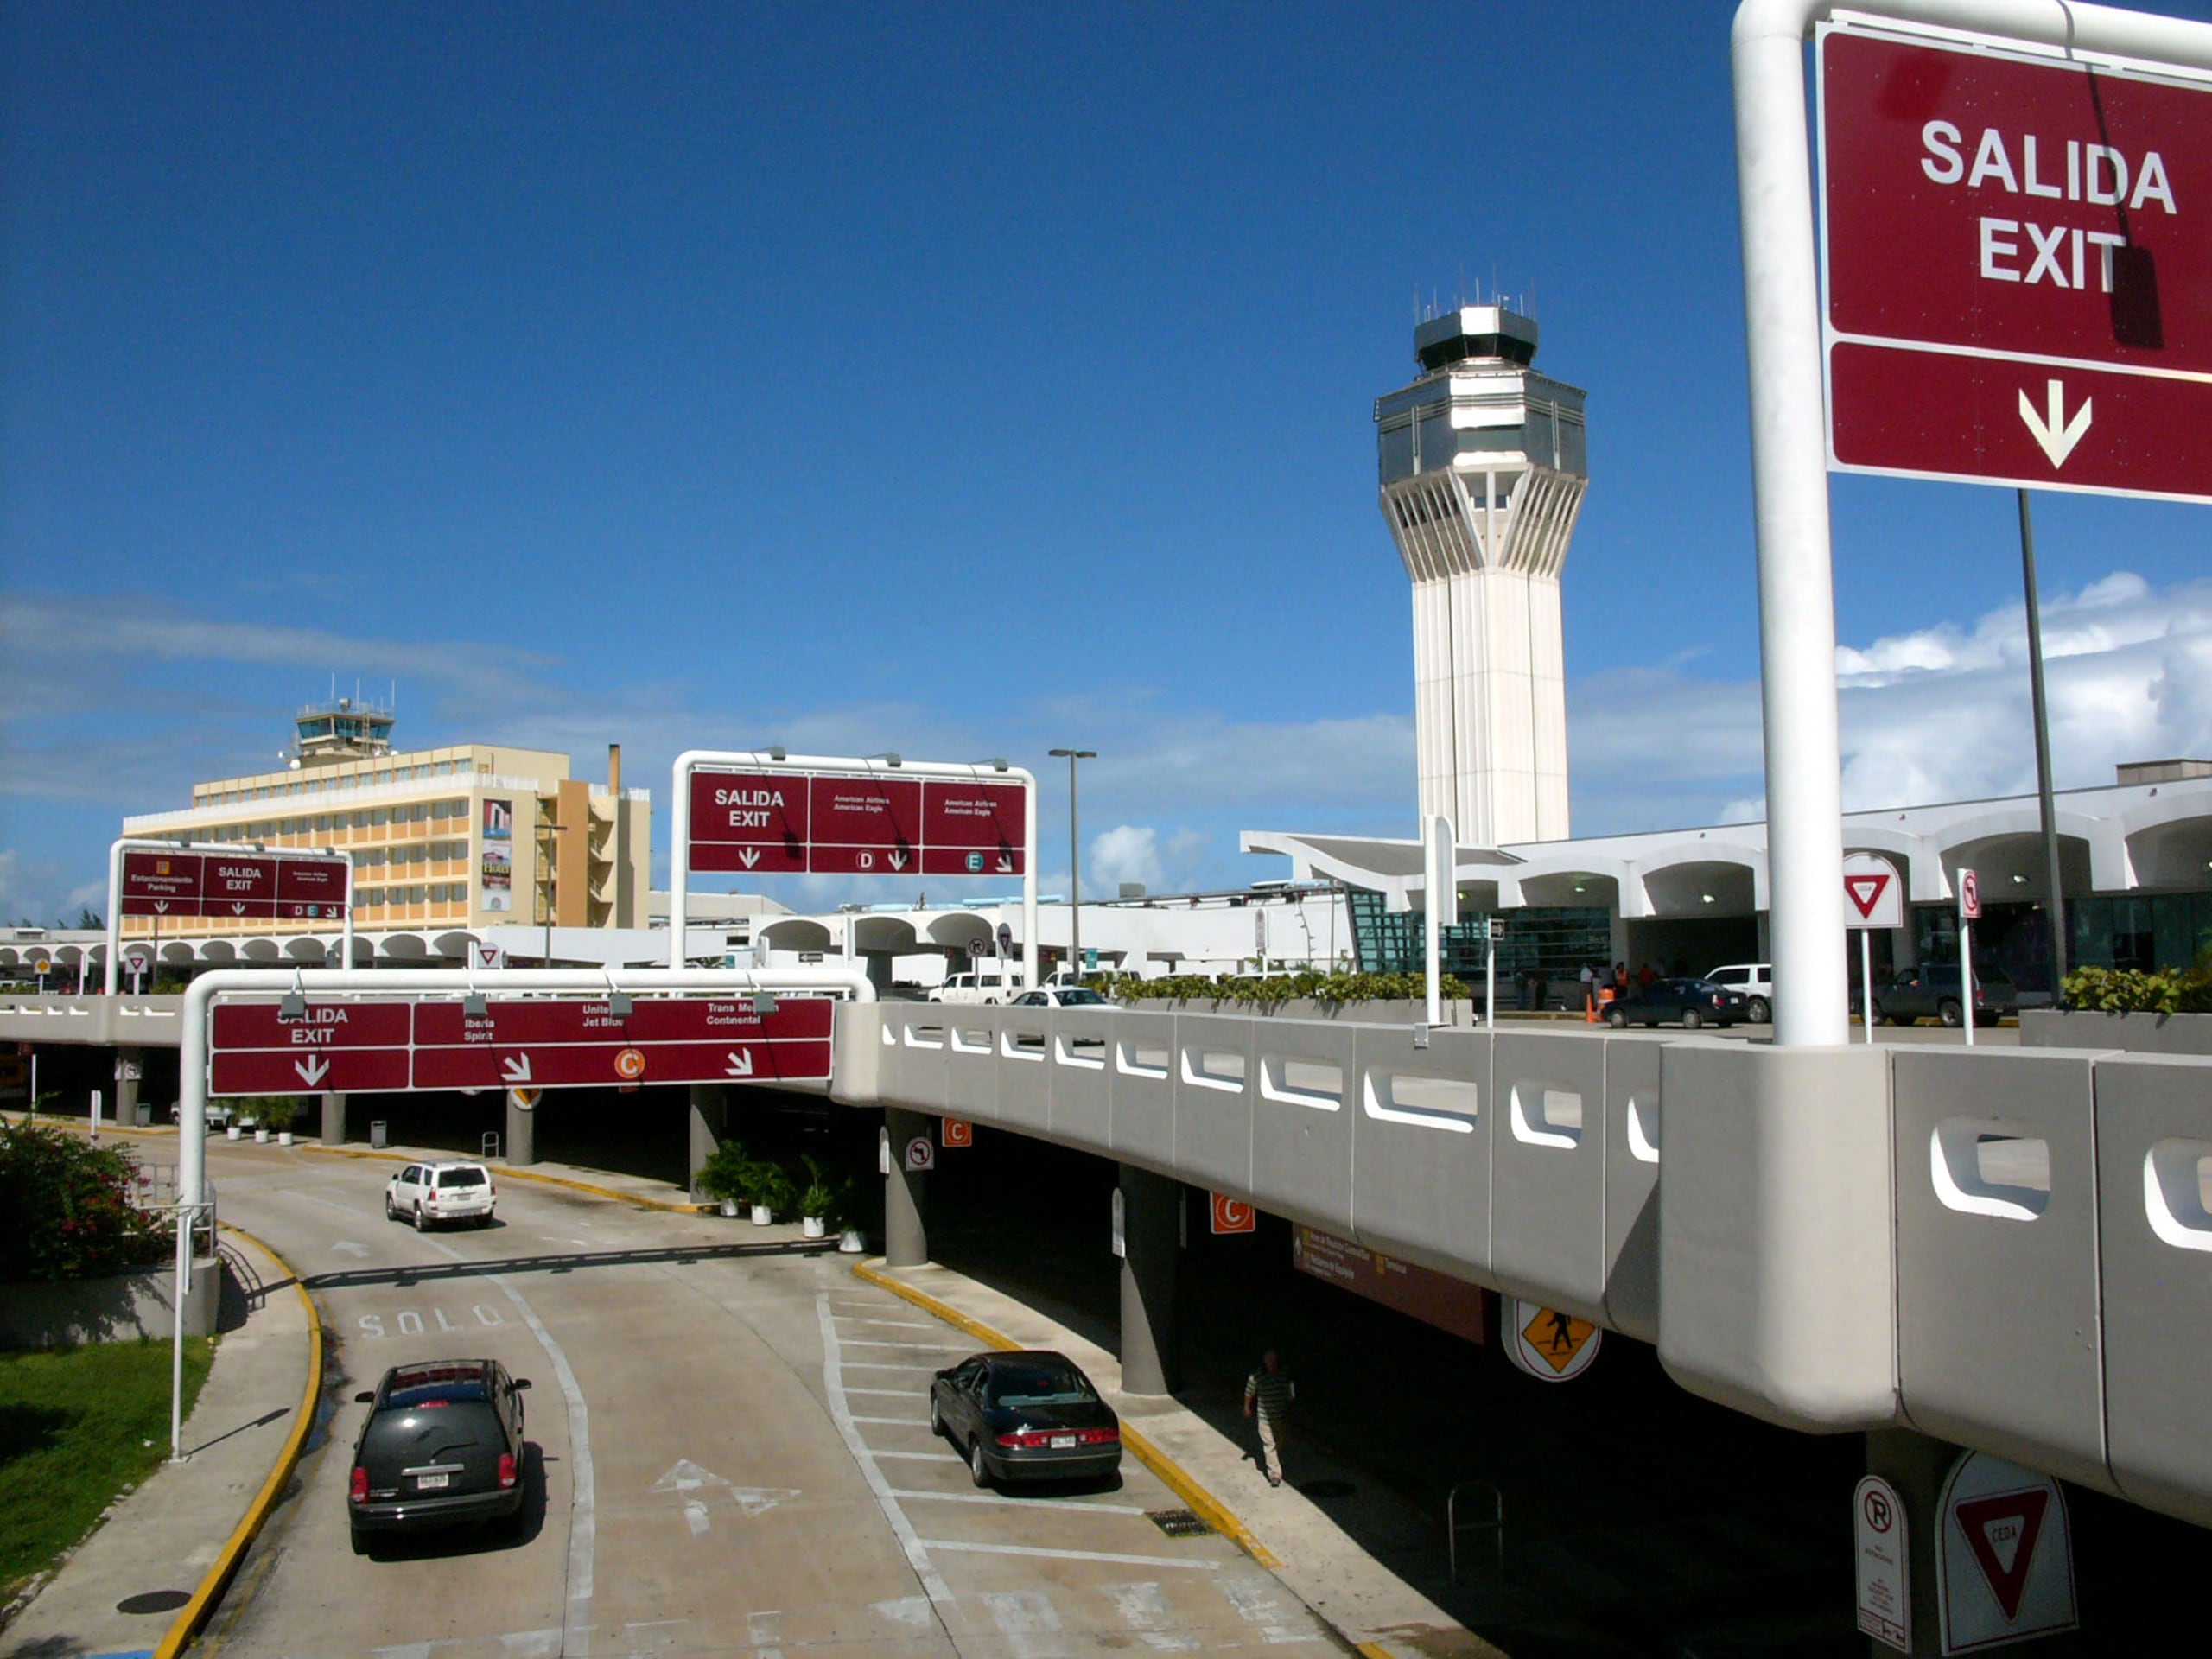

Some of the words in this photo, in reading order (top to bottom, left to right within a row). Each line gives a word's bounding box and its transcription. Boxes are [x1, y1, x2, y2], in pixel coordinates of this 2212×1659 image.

[1921, 119, 2177, 214] SALIDA
[1979, 216, 2127, 293] EXIT
[715, 789, 785, 807] SALIDA
[834, 795, 864, 804] American
[866, 796, 890, 805] Airlines
[834, 803, 864, 811] American
[865, 804, 883, 813] Eagle
[944, 806, 973, 815] American
[974, 808, 991, 817] Eagle
[729, 810, 771, 828] EXIT
[861, 853, 873, 868] D
[969, 854, 979, 869] E
[219, 866, 262, 879] SALIDA
[484, 863, 510, 874] Hotel
[131, 874, 194, 884] Estacionamiento
[148, 883, 176, 893] Parking
[226, 880, 252, 891] EXIT
[295, 906, 303, 916] D
[308, 906, 316, 916] E
[582, 1005, 610, 1014] Unite
[708, 1002, 734, 1013] Trans
[465, 1019, 495, 1028] Iberia
[582, 1017, 599, 1027] Jet
[601, 1017, 624, 1027] Blue
[706, 1015, 761, 1025] Continental
[291, 1028, 335, 1044] EXIT
[464, 1032, 493, 1042] Spirit
[621, 1053, 639, 1074] C
[952, 1122, 963, 1140] C
[1224, 1199, 1241, 1222] C
[358, 1304, 505, 1338] SOLO
[1992, 1526, 2018, 1542] CEDA
